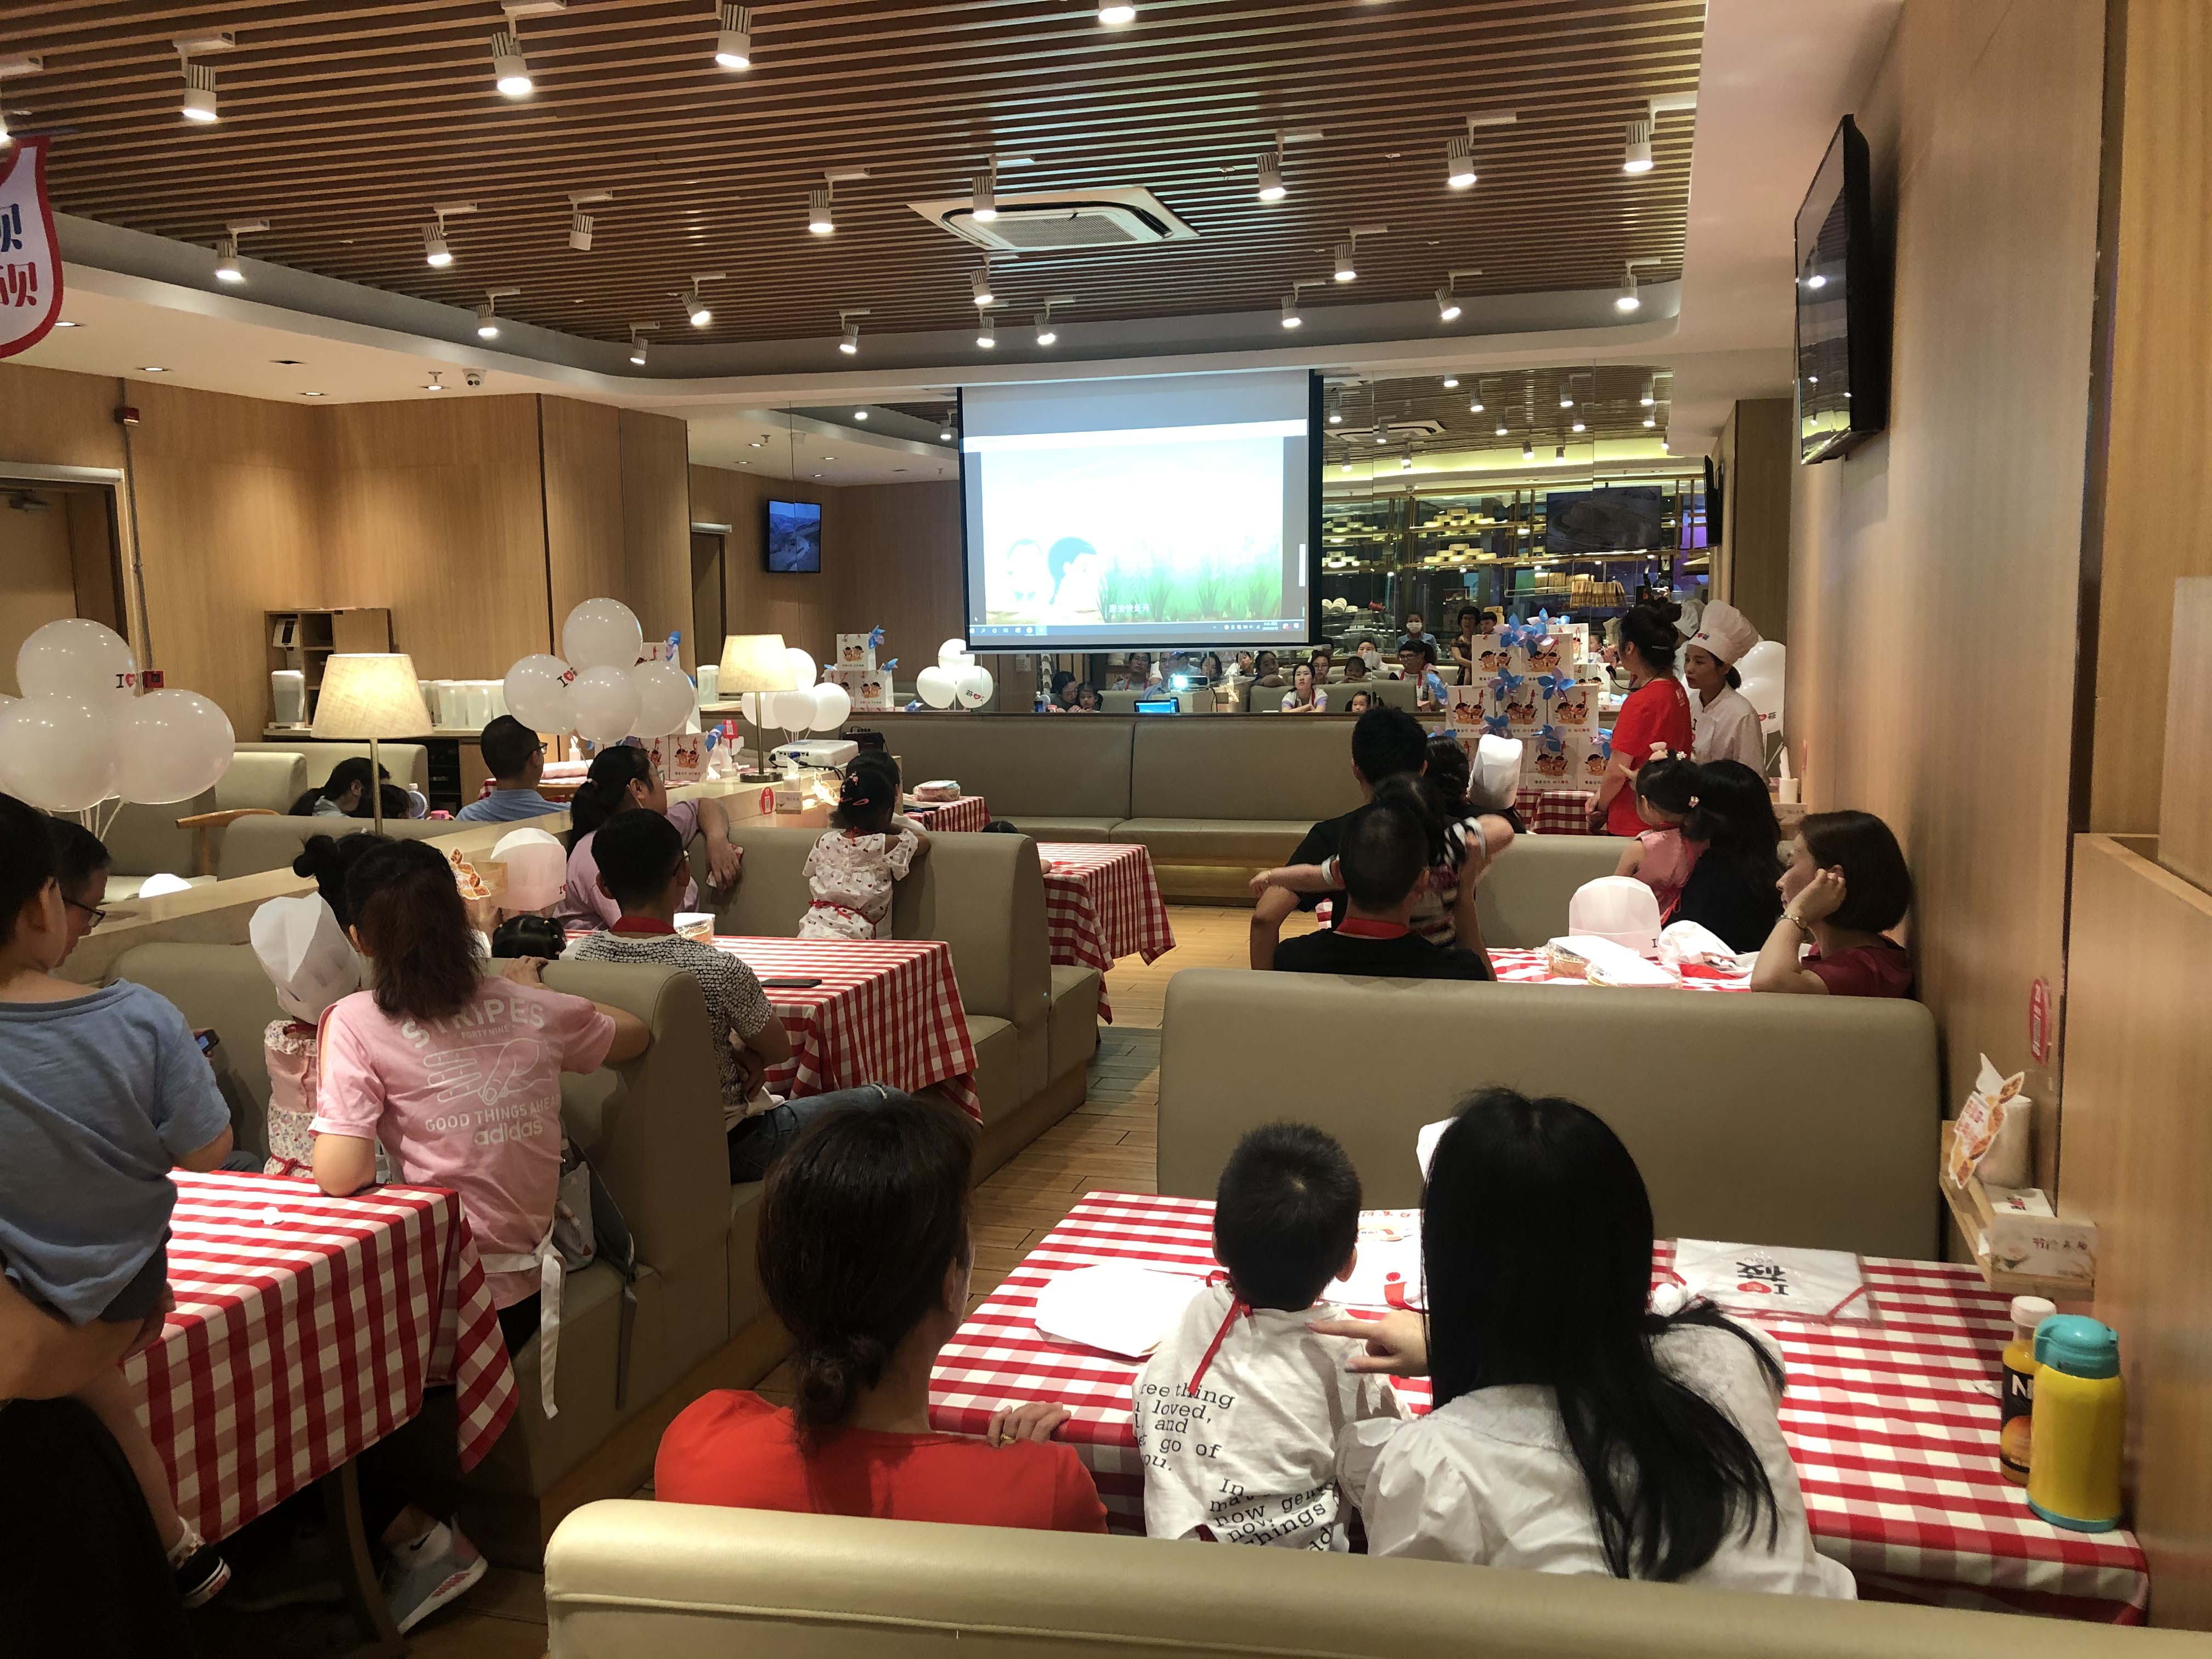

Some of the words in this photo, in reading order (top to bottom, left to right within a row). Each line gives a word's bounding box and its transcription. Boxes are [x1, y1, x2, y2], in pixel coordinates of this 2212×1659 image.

[425, 1114, 470, 1132] GOOD
[474, 1105, 527, 1124] THINGS
[474, 1120, 543, 1146] adidas
[1152, 1400, 1211, 1424] loved,
[1155, 1418, 1188, 1434] and
[1159, 1438, 1181, 1453] go
[1195, 1444, 1222, 1459] of
[1142, 1454, 1172, 1471] ou.
[1219, 1478, 1244, 1497] In
